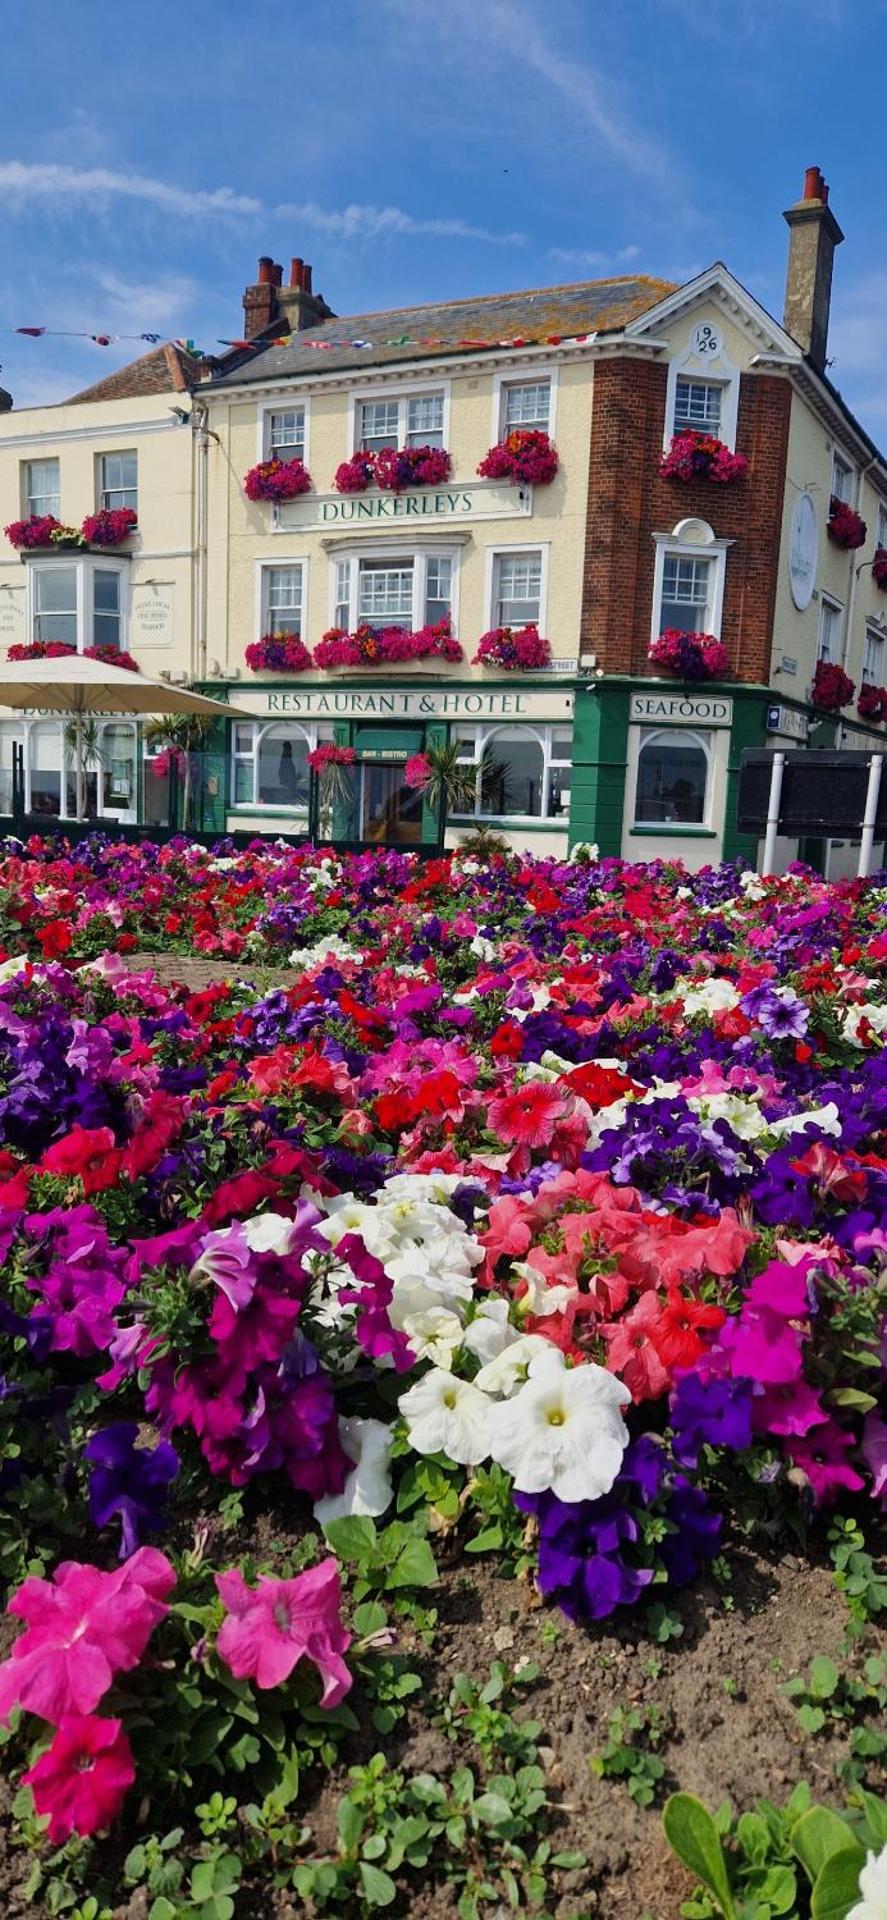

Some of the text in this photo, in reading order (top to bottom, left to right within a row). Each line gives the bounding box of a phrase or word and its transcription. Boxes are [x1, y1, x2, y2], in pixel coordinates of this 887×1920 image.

[323, 492, 473, 521] DUNKERLEYS
[267, 694, 527, 713] RESTAURANT & HOTEL
[634, 699, 727, 718] SEAFOOD
[382, 750, 408, 758] BISTRO
